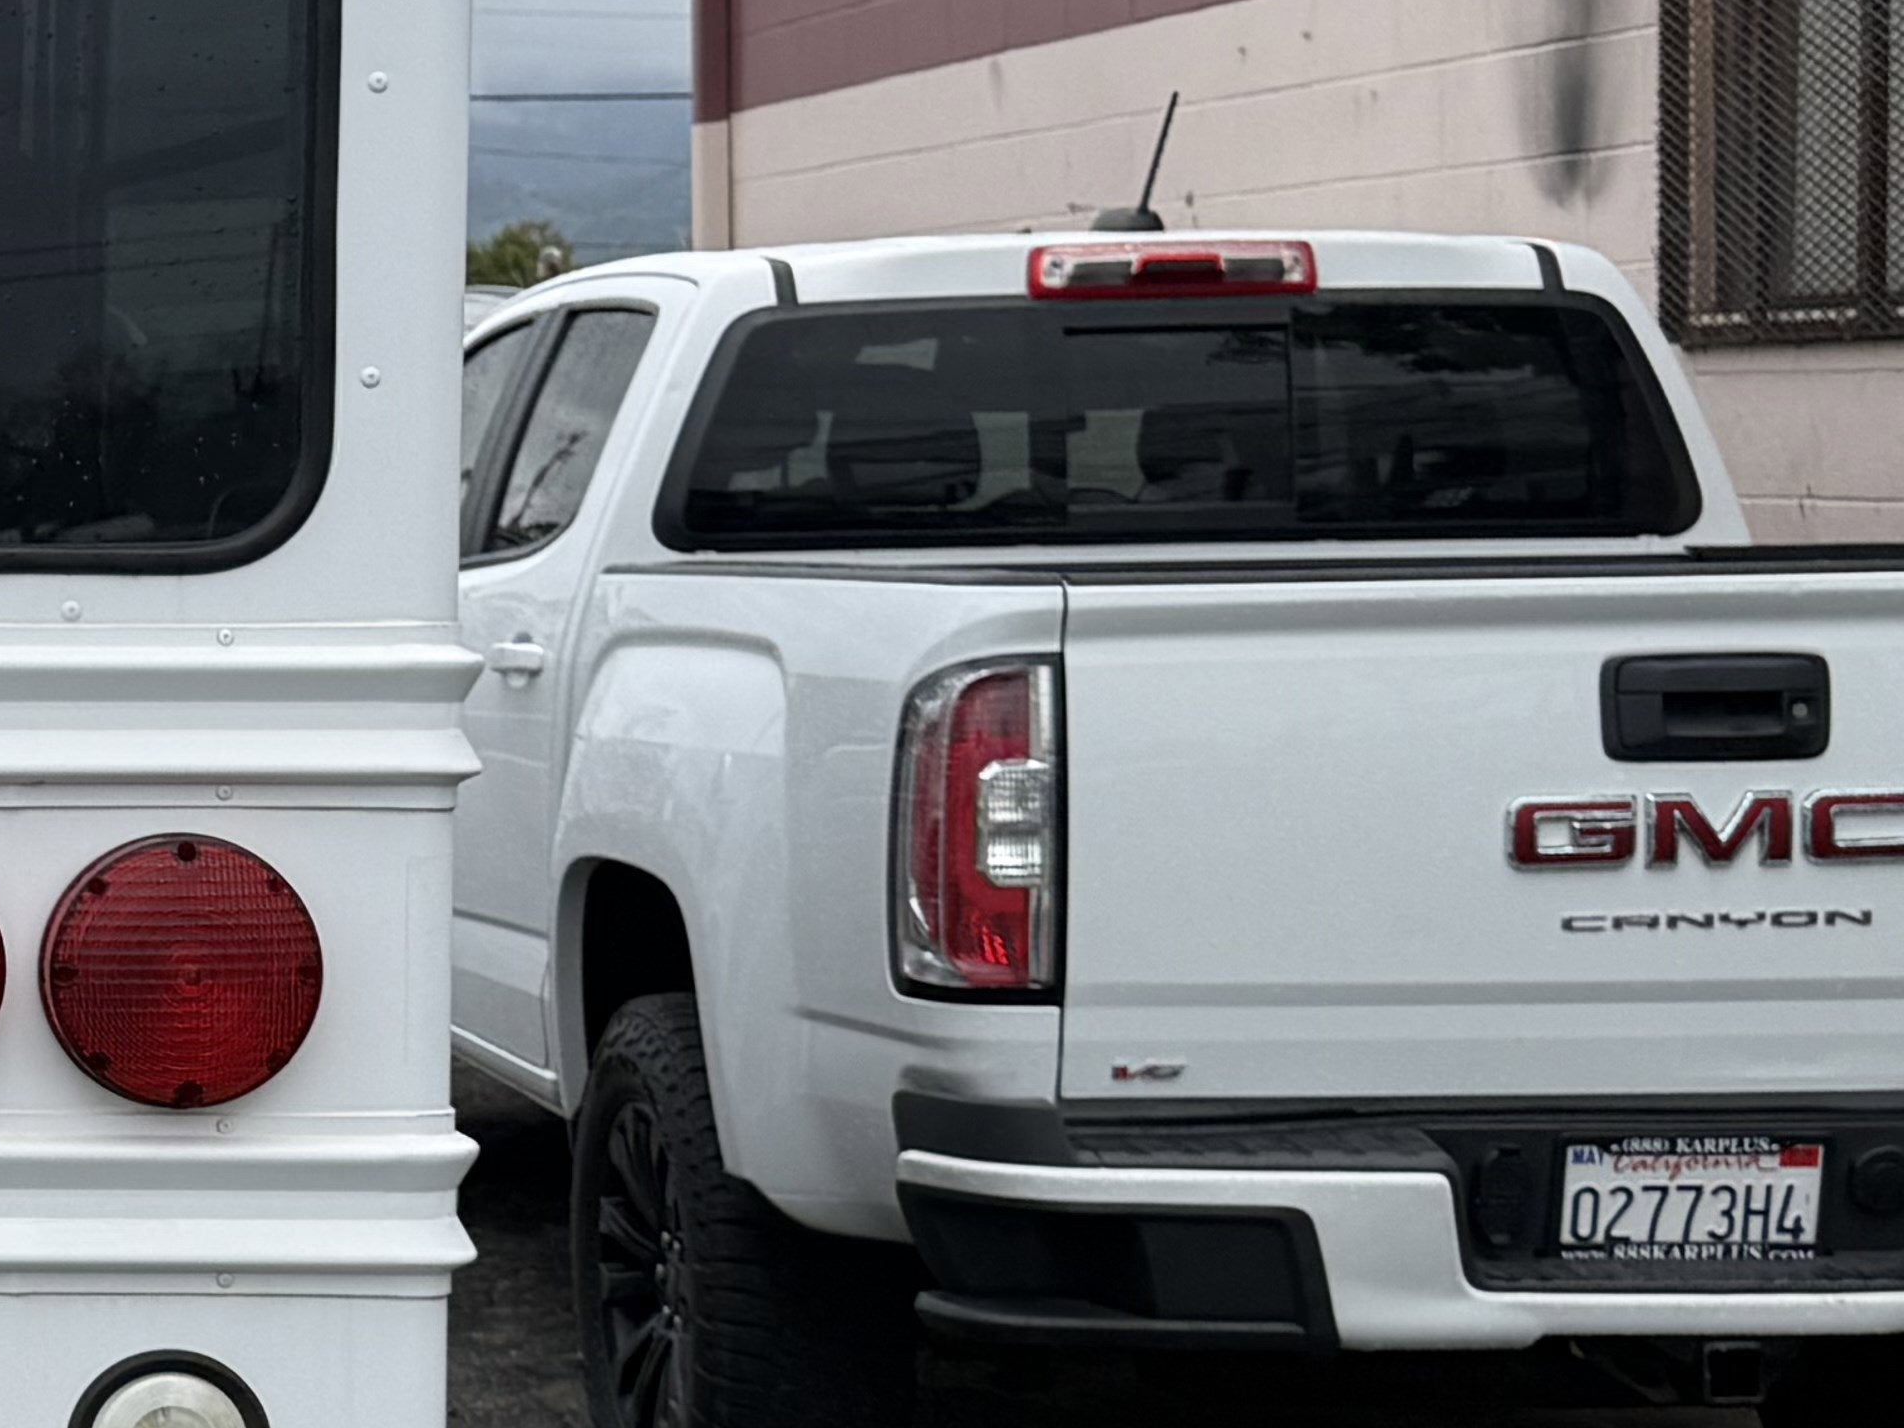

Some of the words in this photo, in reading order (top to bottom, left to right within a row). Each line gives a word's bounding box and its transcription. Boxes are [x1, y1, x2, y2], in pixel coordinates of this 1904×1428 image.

[1506, 788, 1904, 870] GMC
[1561, 909, 1873, 933] CANYON
[1676, 1137, 1770, 1153] KARPLUS
[1570, 1183, 1804, 1243] 02773H4
